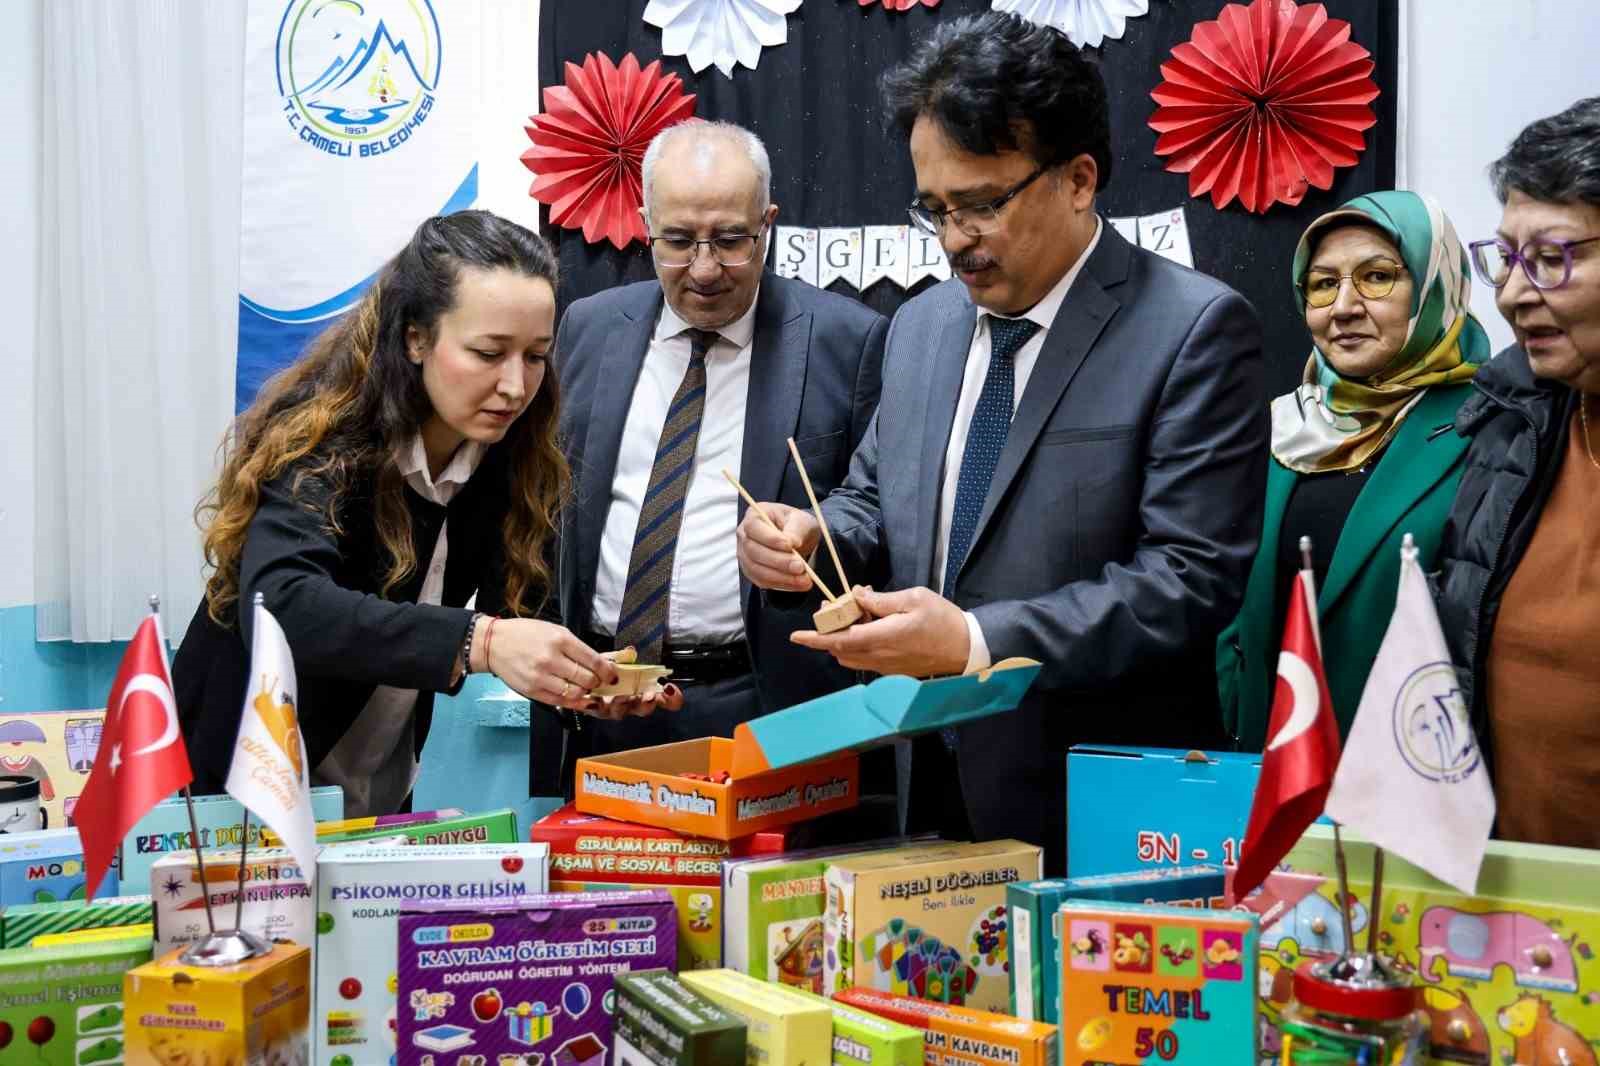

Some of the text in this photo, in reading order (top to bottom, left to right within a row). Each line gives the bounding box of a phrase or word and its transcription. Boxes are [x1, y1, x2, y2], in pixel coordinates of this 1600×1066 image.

[299, 124, 351, 157] ÇAMELİ
[359, 92, 436, 158] BELEDİYESİ
[344, 126, 368, 135] 1953
[584, 770, 717, 818] Matematik Oyunları
[737, 787, 801, 821] Matematik
[578, 839, 730, 855] SIRALAMA KARTLARIYLA
[1138, 830, 1180, 863] 5N
[599, 858, 615, 870] VE
[620, 860, 672, 873] SOSYAL
[331, 881, 450, 900] PSİKOMOTOR
[880, 867, 1019, 900] NEŞELİ DÜĞMELER
[922, 897, 946, 911] Beni
[418, 927, 490, 941] EVDE OKULDA
[588, 919, 653, 932] 25 KİTAP
[419, 935, 657, 968] KAVRAM ÖĞRETİM SETİ
[444, 961, 631, 985] DOĞRUDAN ÖĞRETİM YÖNTEMİ
[1102, 985, 1210, 1021] TEMEL
[952, 1036, 1018, 1063] KAVRAMI
[1134, 1027, 1179, 1062] 50
